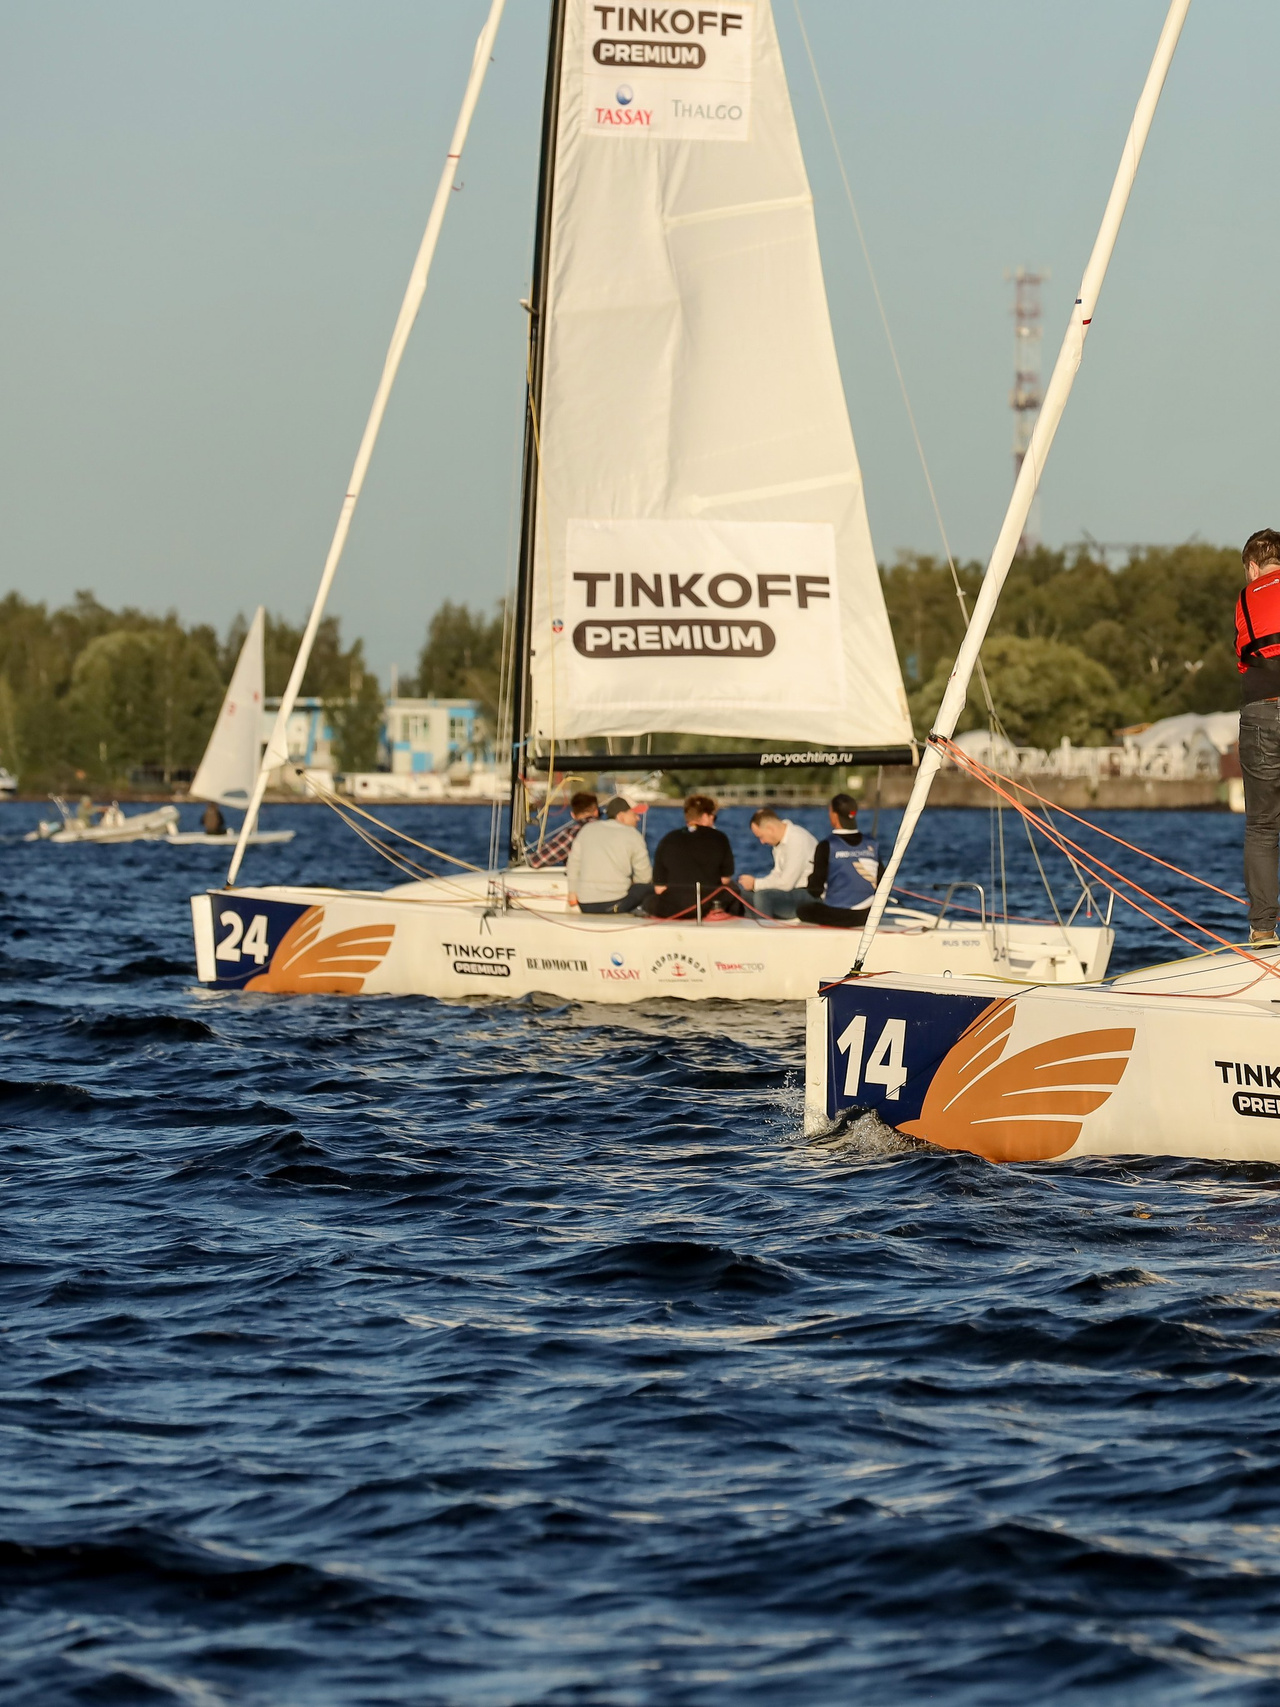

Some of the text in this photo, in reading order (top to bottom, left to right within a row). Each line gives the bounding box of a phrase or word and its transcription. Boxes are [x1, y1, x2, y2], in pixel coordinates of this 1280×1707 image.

[594, 5, 742, 36] TINKOFF
[599, 42, 699, 65] PREMIUM
[595, 107, 653, 126] TASSAY
[573, 572, 830, 609] TINKOFF
[585, 625, 763, 651] PREMIUM
[760, 751, 853, 766] pro-yachting.ru
[216, 910, 269, 965] 24
[442, 943, 516, 960] TINKOFF
[455, 962, 509, 976] PREMIUM
[526, 957, 588, 972] ВЕДОМОСТИ
[600, 968, 640, 980] TASSAY
[837, 1015, 907, 1100] 14
